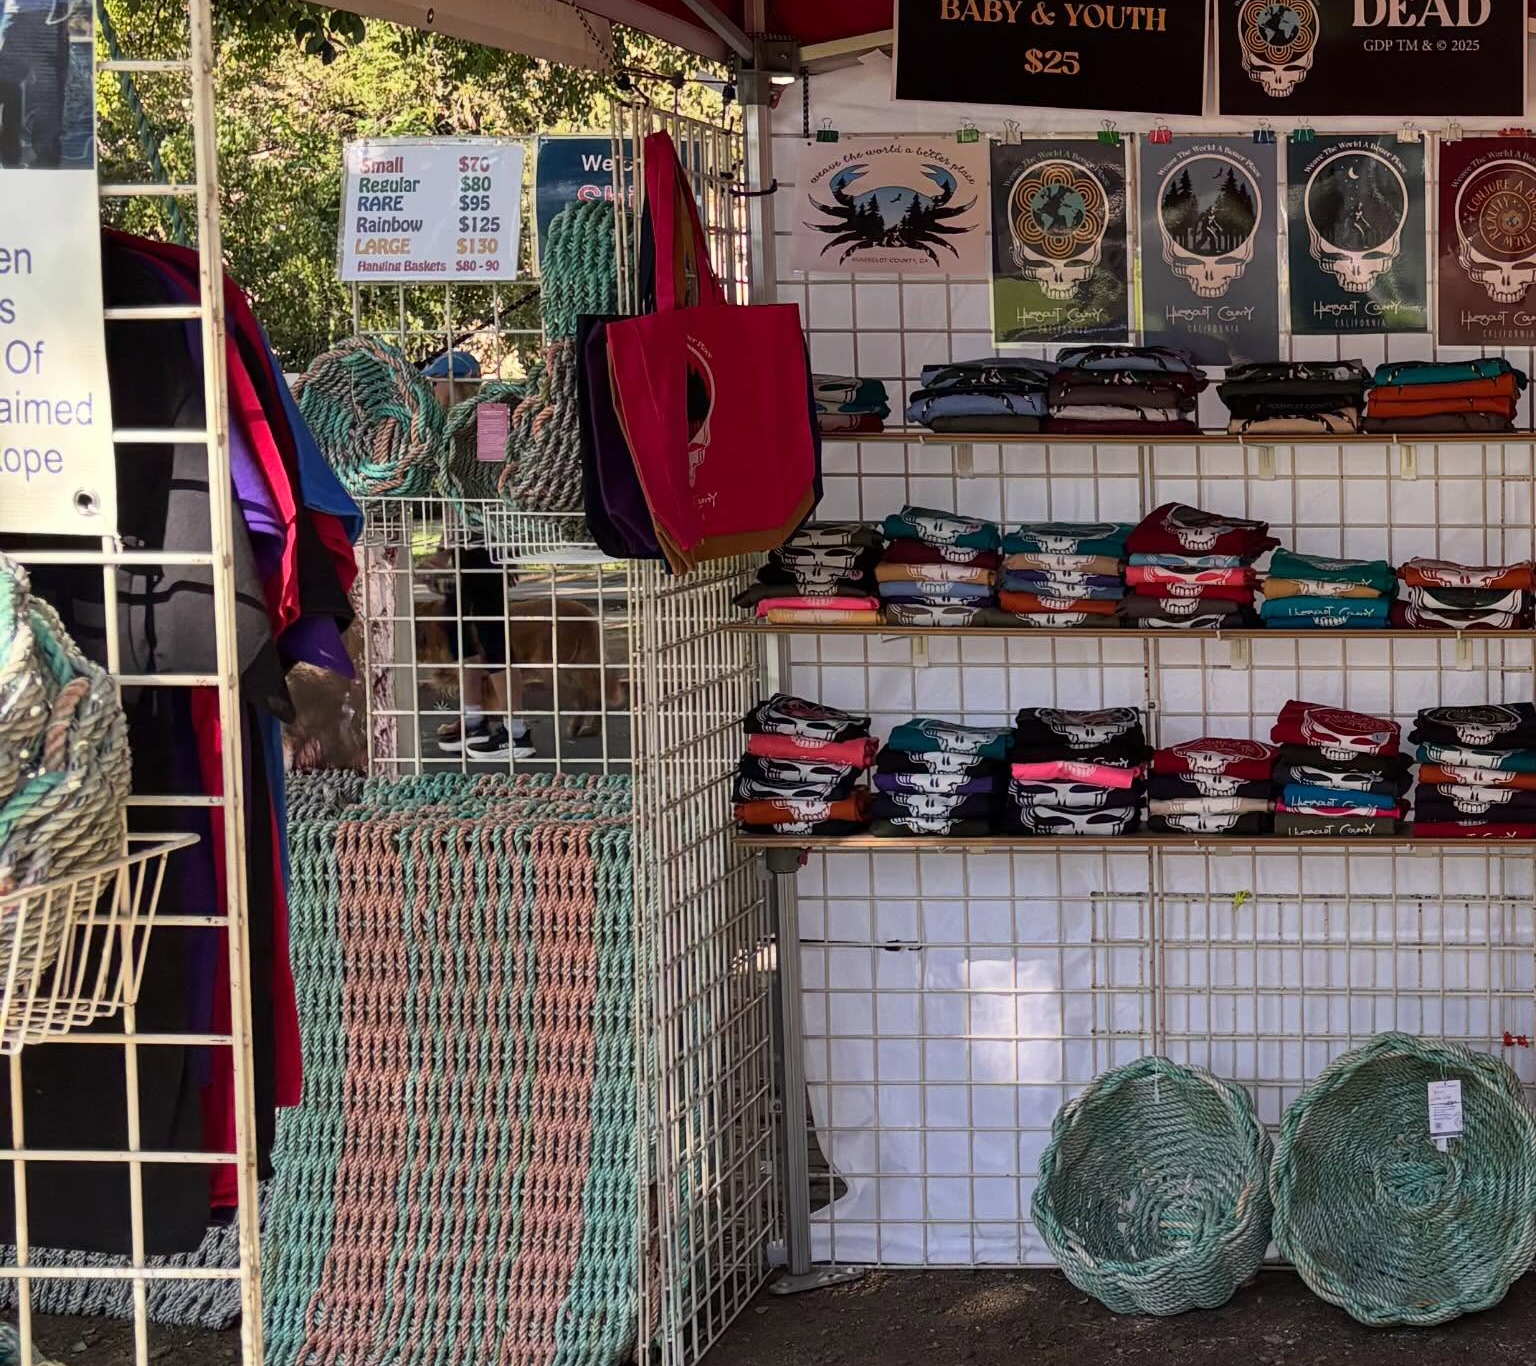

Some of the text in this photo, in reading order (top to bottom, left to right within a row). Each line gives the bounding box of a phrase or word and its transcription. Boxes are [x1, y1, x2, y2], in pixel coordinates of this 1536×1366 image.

[1030, 1, 1055, 26] &
[1068, 2, 1167, 32] YOUTH
[1363, 38, 1392, 52] GDP
[1397, 38, 1418, 52] TM
[1421, 38, 1433, 52] &
[1451, 38, 1480, 52] 2025
[1024, 49, 1080, 75] $25
[360, 156, 404, 174] Small
[810, 161, 842, 184] weave
[843, 152, 864, 163] the
[865, 144, 903, 156] world
[916, 146, 951, 165] better
[949, 162, 976, 185] place
[359, 176, 492, 194] Regular $80
[357, 195, 490, 212] RARE $95
[1466, 179, 1510, 212] CONJURE
[1514, 180, 1524, 192] A
[356, 216, 500, 233] Rainbow $125
[355, 238, 498, 255] LARGE $130
[357, 260, 401, 273] Hanging
[404, 260, 447, 272] Baskets
[5, 339, 45, 375] Of
[0, 447, 63, 482] ope
